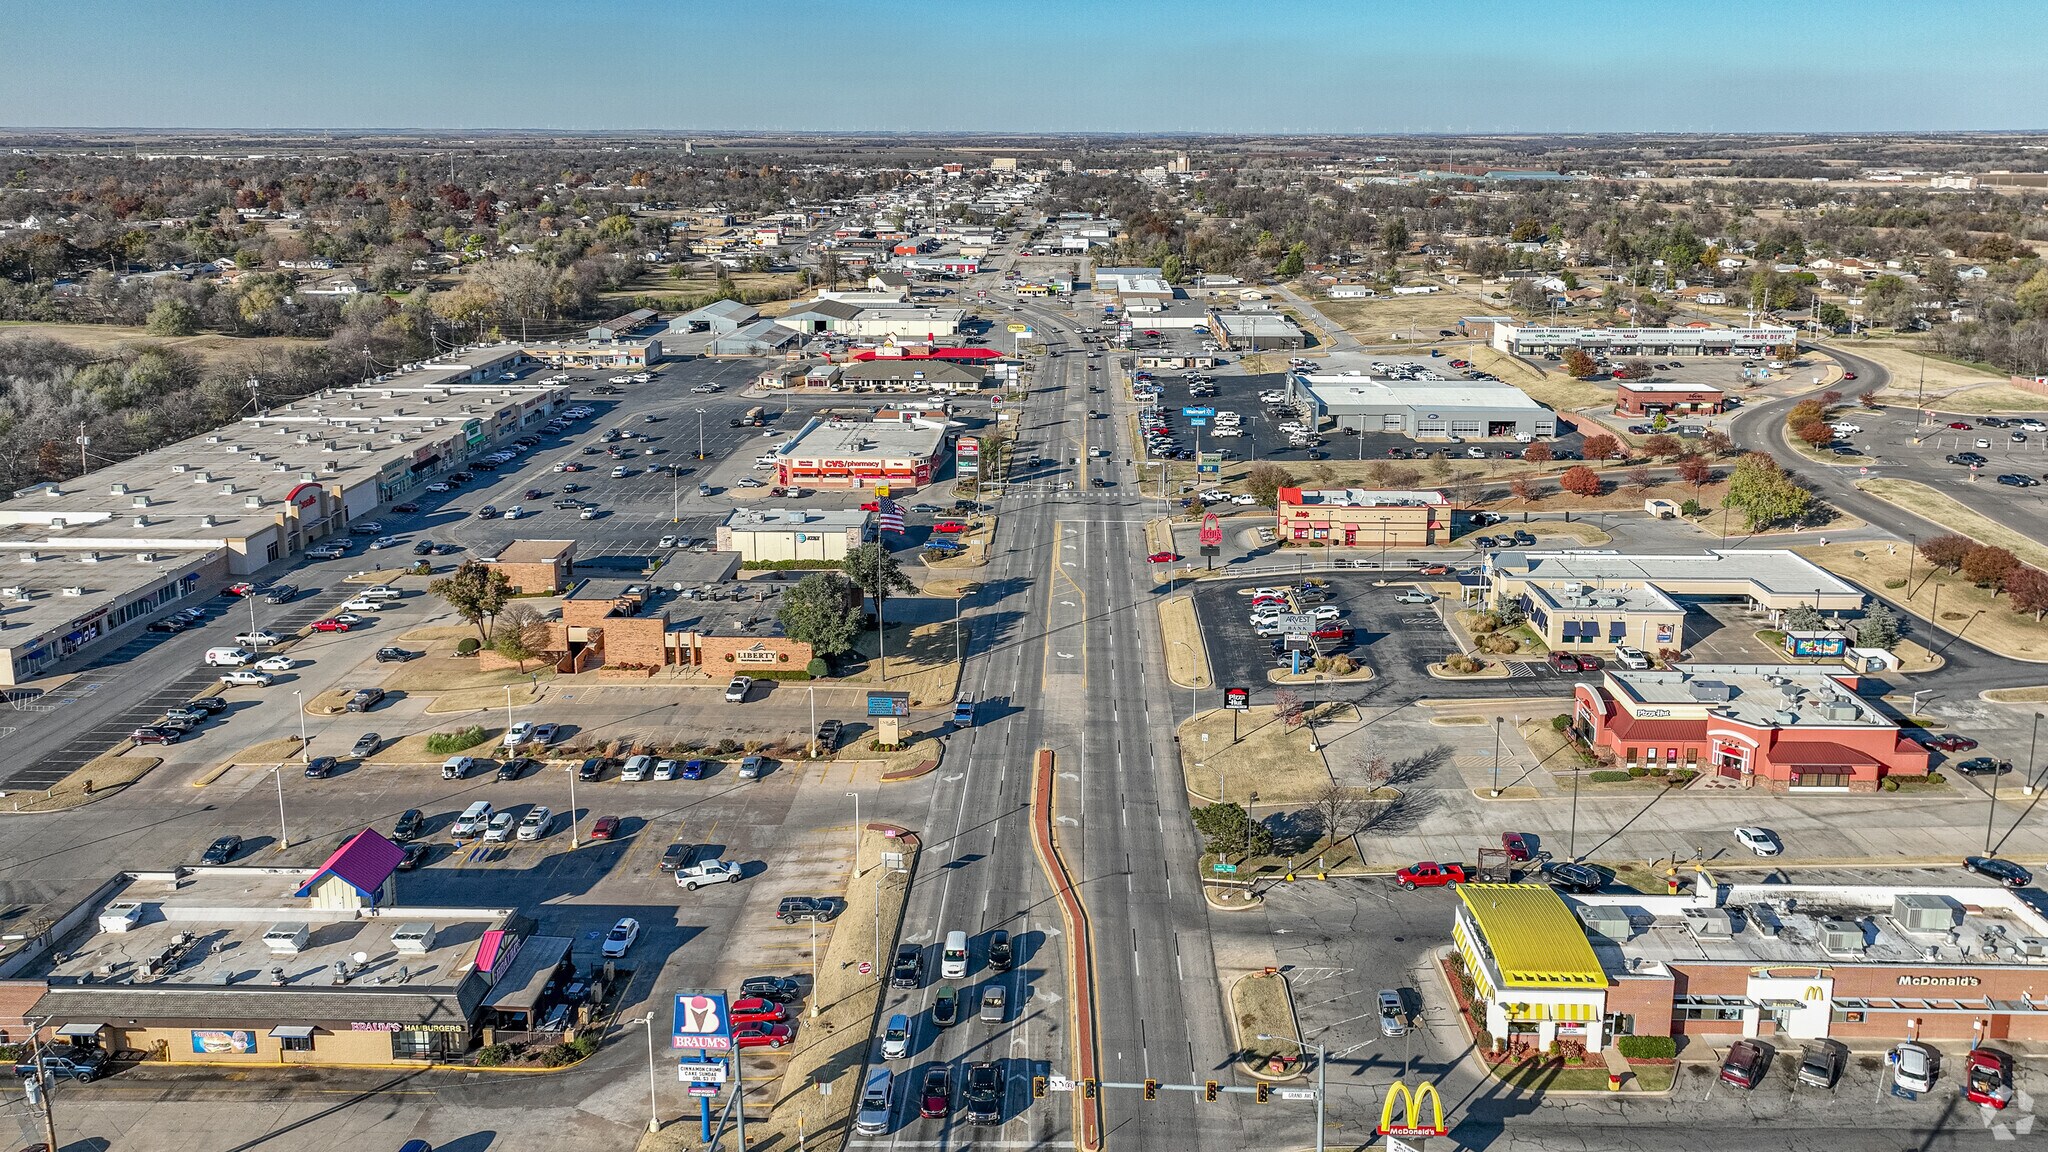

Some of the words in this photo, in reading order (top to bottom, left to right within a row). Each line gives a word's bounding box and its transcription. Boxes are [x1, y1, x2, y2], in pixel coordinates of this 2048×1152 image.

[1285, 616, 1311, 624] ARVEST
[1636, 709, 1656, 717] Pizza
[1656, 709, 1671, 717] Hut
[1899, 976, 1980, 987] McDonald's
[351, 1022, 402, 1033] BRAUM'S
[404, 1024, 462, 1032] HAMBURGERS
[675, 1036, 727, 1048] BRAUM'S
[1389, 1128, 1435, 1136] McDonald's
